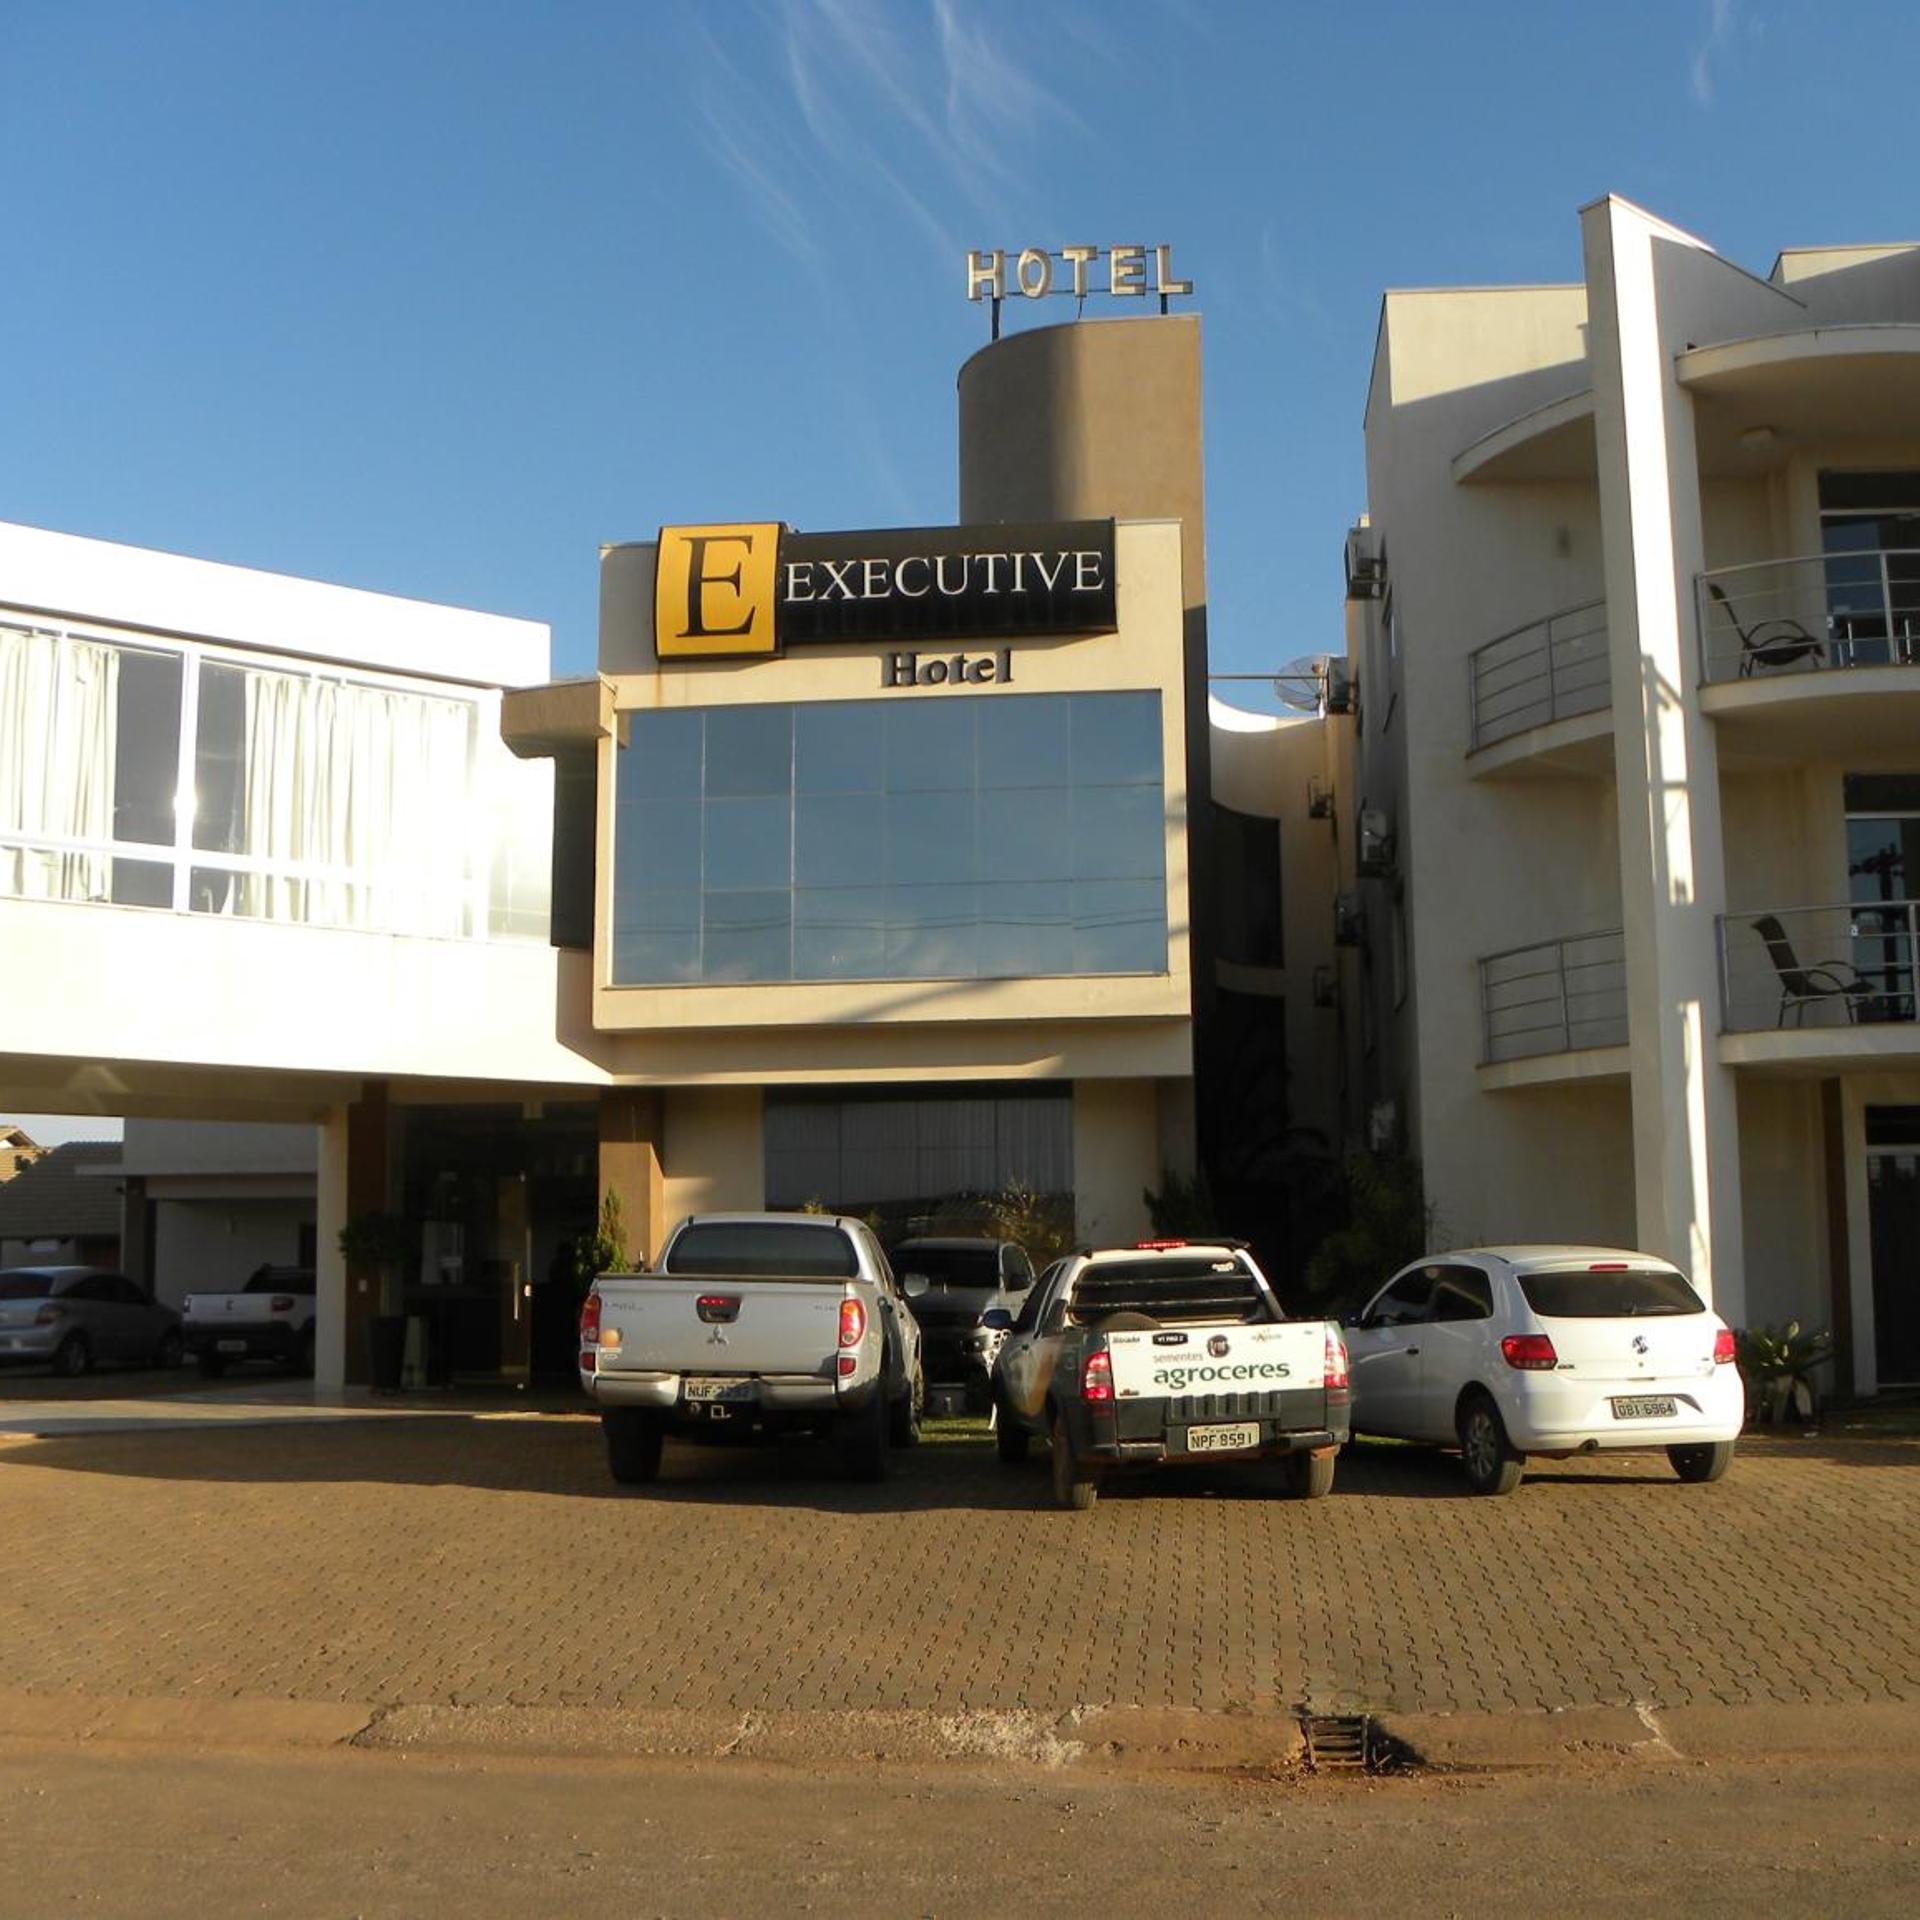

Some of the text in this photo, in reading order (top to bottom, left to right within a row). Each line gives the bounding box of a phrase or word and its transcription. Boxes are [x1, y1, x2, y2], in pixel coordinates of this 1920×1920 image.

[967, 245, 1193, 301] HOTEL
[675, 535, 757, 637] E
[784, 551, 1106, 602] EXECUTIVE
[885, 648, 1013, 687] Hotel
[1153, 1350, 1204, 1364] sementes
[1153, 1361, 1290, 1389] agroceres
[1191, 1434, 1217, 1449] NPF
